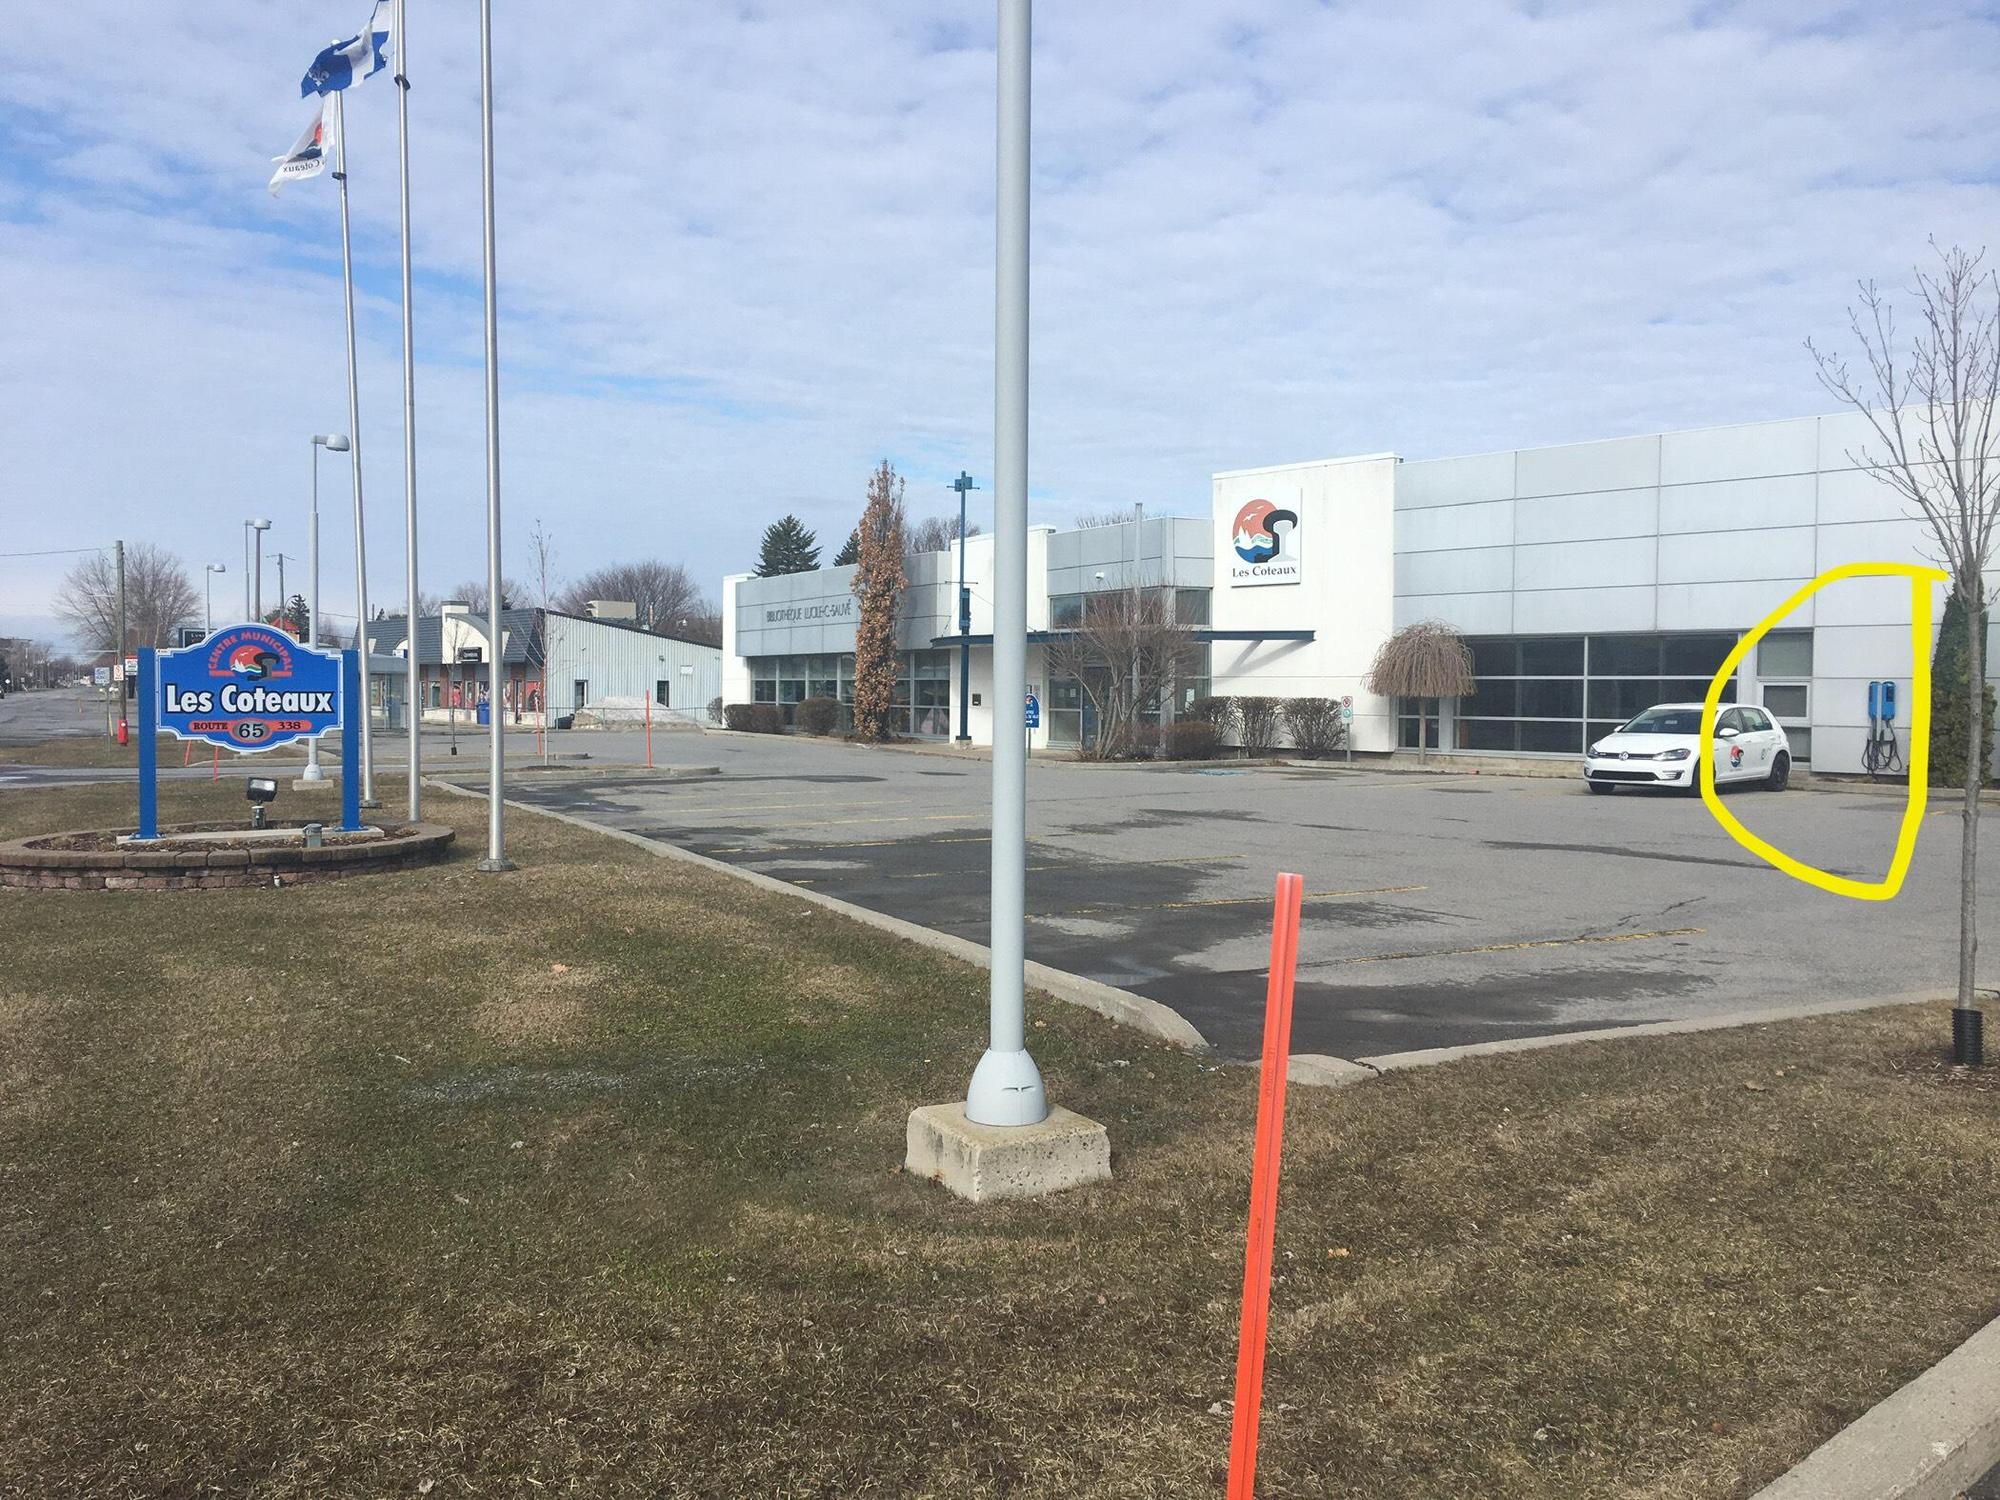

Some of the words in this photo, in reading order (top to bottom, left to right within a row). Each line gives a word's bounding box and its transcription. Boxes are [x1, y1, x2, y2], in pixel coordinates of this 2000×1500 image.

[1232, 567, 1250, 578] Les
[1252, 565, 1296, 576] Coteaux
[208, 635, 238, 669] CENTRE
[240, 631, 293, 669] MUNICIPAL
[166, 684, 214, 713] Les
[220, 684, 333, 713] Coteaux
[193, 722, 228, 730] ROUTE
[238, 723, 264, 738] 65
[278, 721, 301, 730] 338
